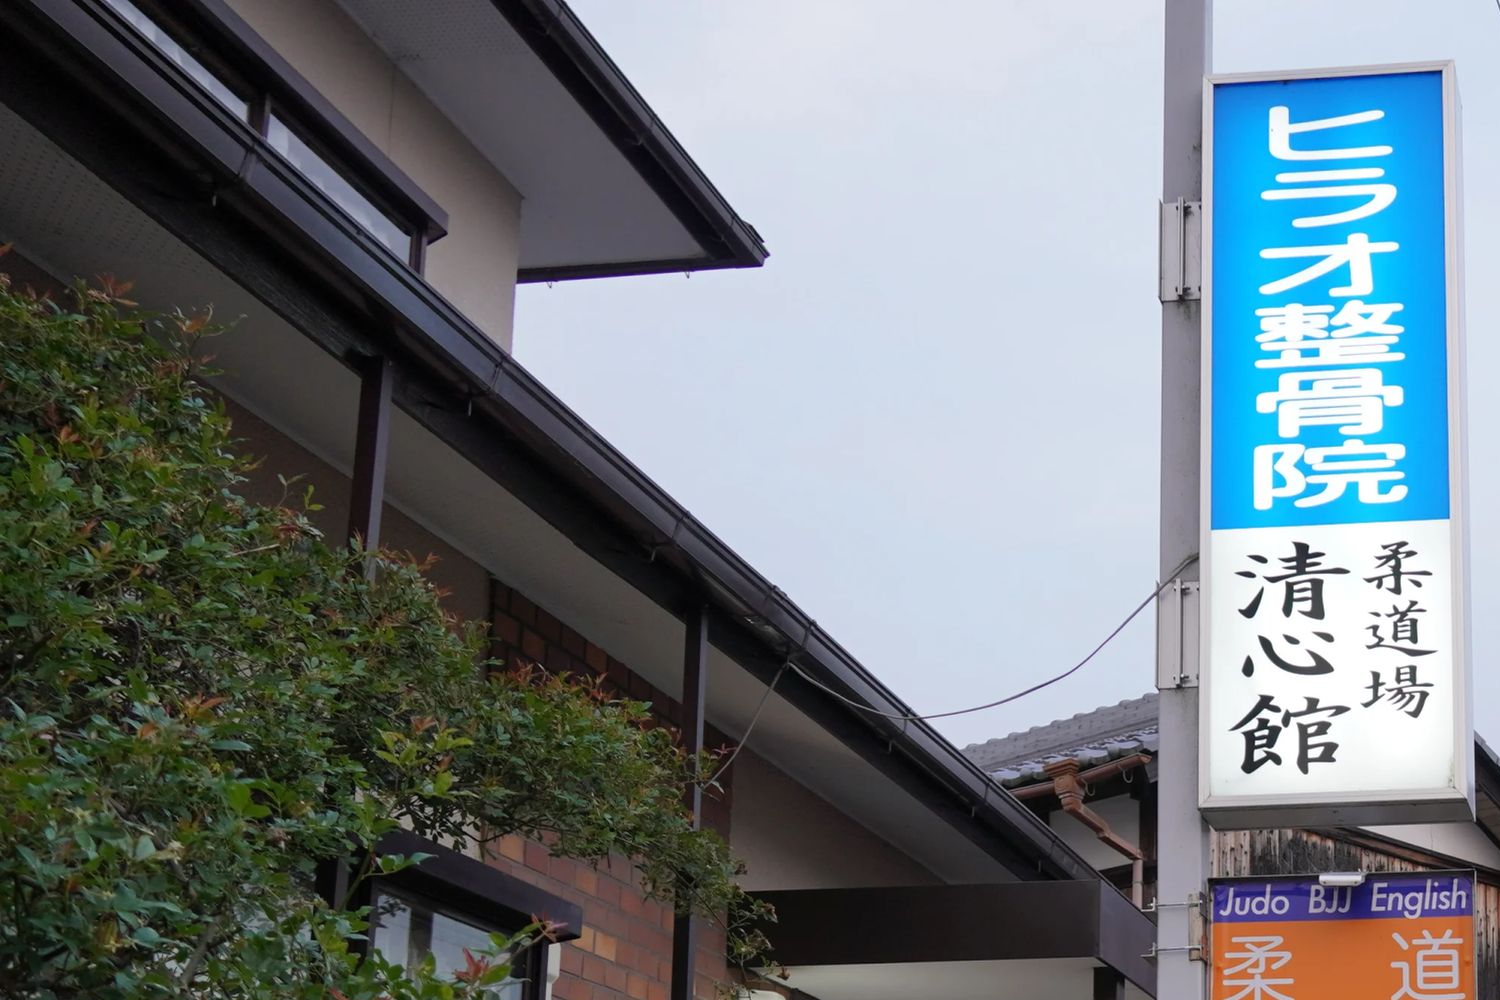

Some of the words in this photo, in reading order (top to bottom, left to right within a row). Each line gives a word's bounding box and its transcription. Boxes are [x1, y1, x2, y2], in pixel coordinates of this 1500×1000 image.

[1253, 105, 1409, 512] ヒラオ整骨院
[1228, 540, 1351, 776] 清心館
[1362, 540, 1438, 721] 柔道場
[1219, 883, 1290, 917] Judo
[1308, 884, 1351, 914] BJJ
[1371, 878, 1467, 920] English
